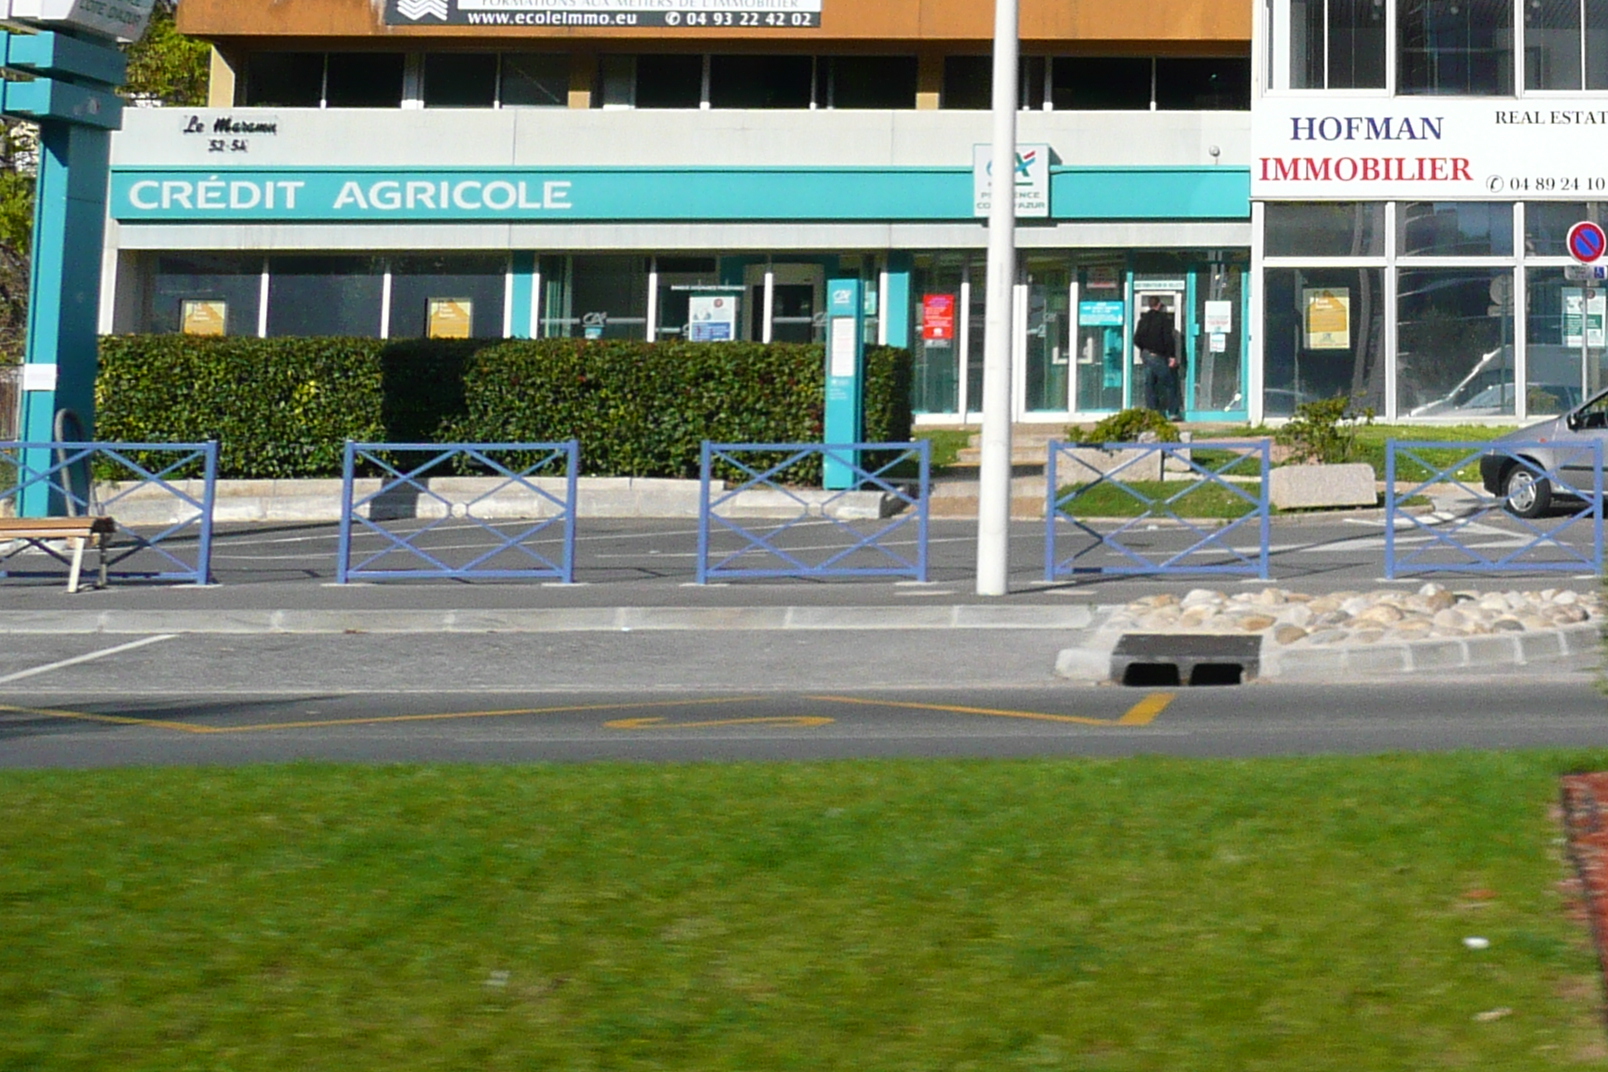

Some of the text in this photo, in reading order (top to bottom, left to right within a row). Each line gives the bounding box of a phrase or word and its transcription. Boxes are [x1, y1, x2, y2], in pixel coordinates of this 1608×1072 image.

[686, 13, 707, 26] 04
[713, 13, 732, 26] 93
[739, 13, 759, 26] 22
[765, 13, 784, 26] 42
[791, 13, 811, 26] 02
[183, 115, 204, 134] Le
[1495, 111, 1545, 125] REAL
[1289, 117, 1444, 141] HOFMAN
[1259, 157, 1473, 182] IMMOBILIER
[128, 175, 572, 211] CRÉDIT AGRICOLE
[1509, 177, 1530, 191] 04
[1535, 177, 1555, 191] 89
[1557, 177, 1579, 191] 24
[1586, 177, 1605, 191] 10
